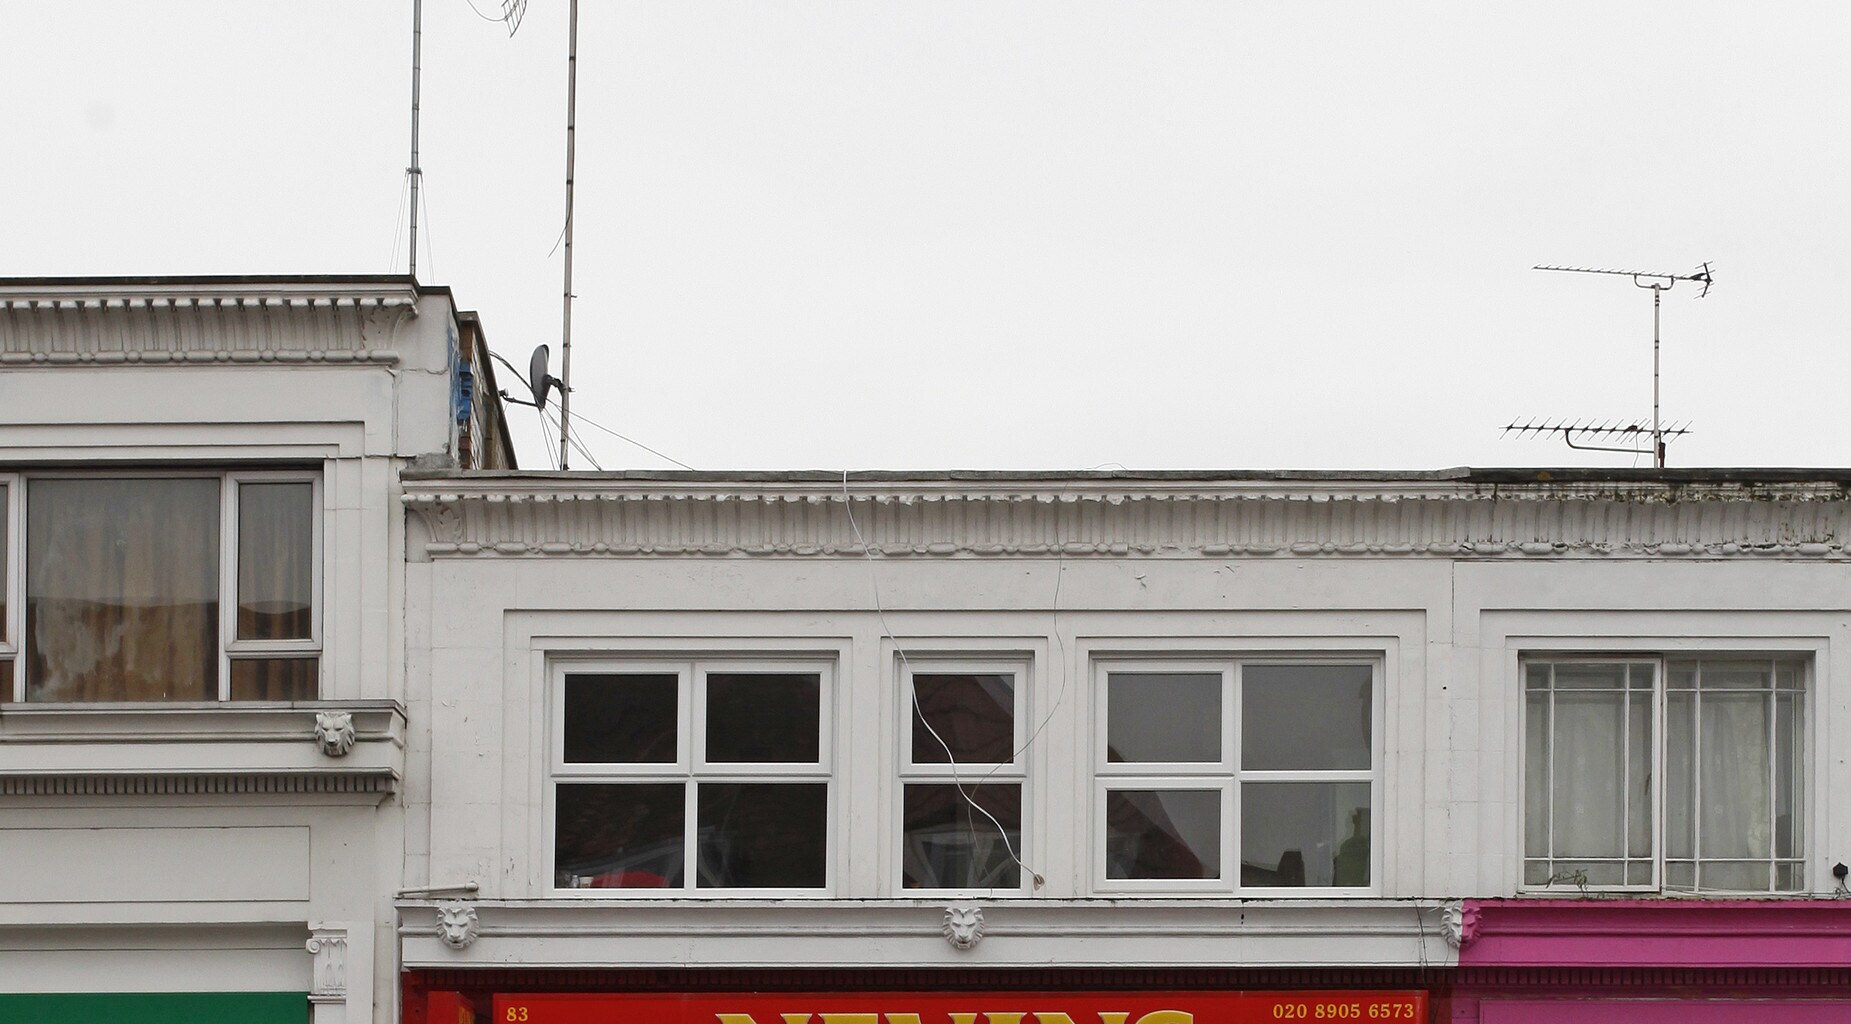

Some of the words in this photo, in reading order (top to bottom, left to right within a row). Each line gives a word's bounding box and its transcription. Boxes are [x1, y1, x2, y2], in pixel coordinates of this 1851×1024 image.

[506, 1006, 529, 1022] 83
[1273, 1003, 1308, 1019] 020
[1315, 1003, 1361, 1019] 8905
[1369, 1003, 1415, 1019] 6573
